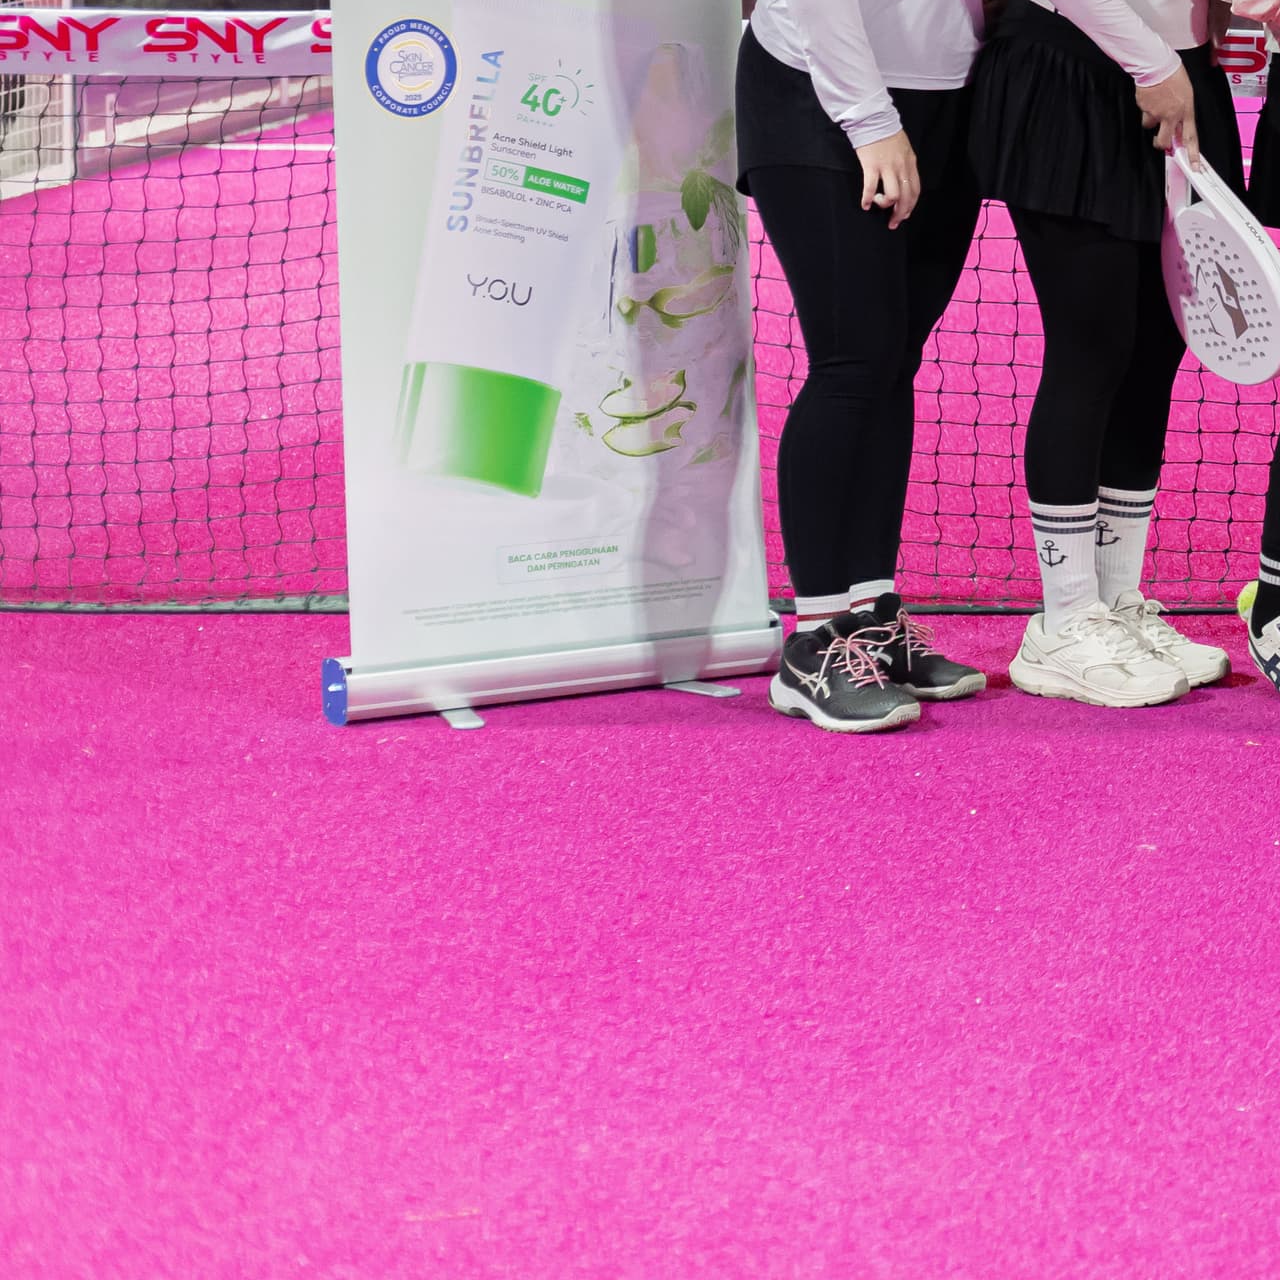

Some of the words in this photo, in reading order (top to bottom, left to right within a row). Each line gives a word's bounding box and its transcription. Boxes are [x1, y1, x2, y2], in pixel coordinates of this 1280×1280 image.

[142, 16, 289, 54] SNY
[378, 23, 407, 45] PROUD
[409, 22, 445, 43] MEMBER
[167, 50, 267, 65] STYLE
[371, 84, 419, 116] CORPORATE
[420, 82, 453, 113] COUNCIL
[447, 49, 505, 233] SUNBRELLA
[490, 142, 538, 161] Sunscreen
[493, 131, 517, 145] Acne
[518, 137, 548, 152] Shield
[549, 140, 575, 159] Light
[491, 164, 521, 182] 50%
[527, 173, 552, 188] ALOE
[481, 185, 528, 204] BISABOLOL
[535, 196, 556, 210] ZINC
[556, 201, 573, 214] PCA
